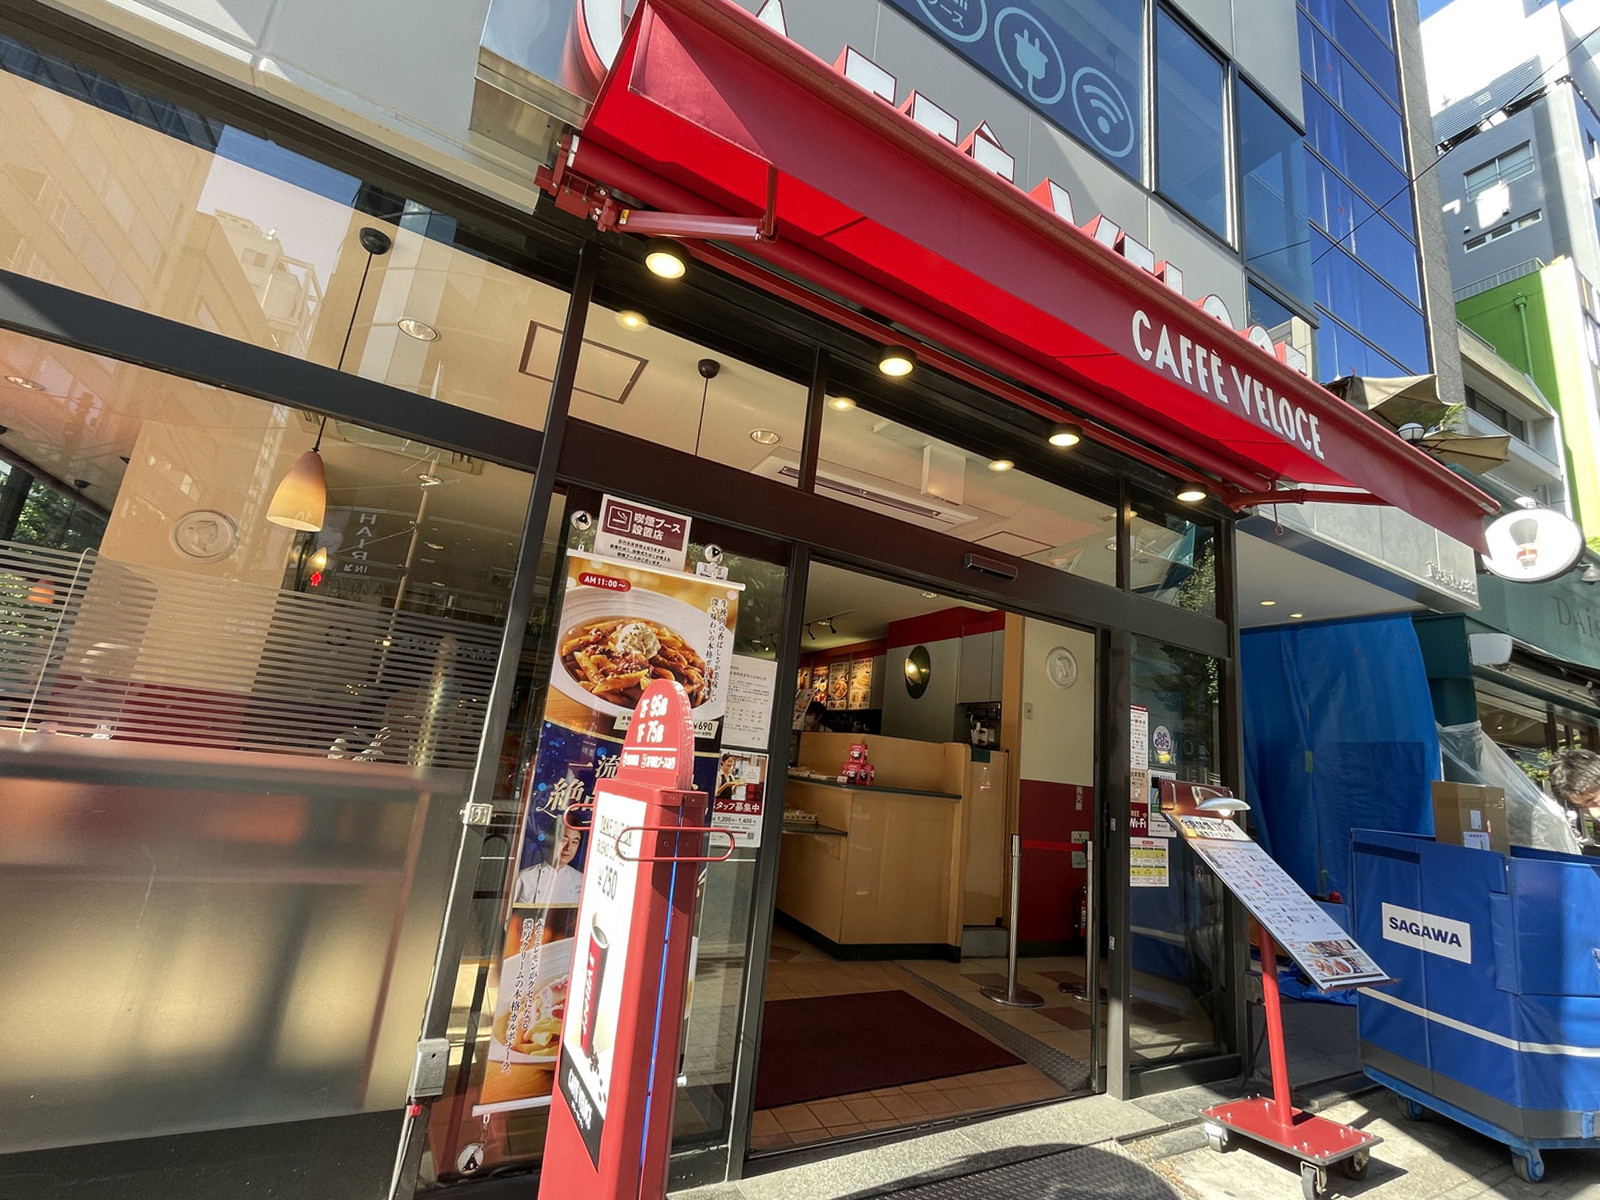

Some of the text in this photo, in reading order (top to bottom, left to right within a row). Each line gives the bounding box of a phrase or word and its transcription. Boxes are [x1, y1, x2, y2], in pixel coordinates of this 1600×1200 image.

[1132, 310, 1324, 460] CAFFÈ VELOCE
[631, 523, 664, 541] 設置店
[633, 512, 681, 534] 喫煙ブース
[584, 576, 597, 584] AM
[1389, 917, 1462, 948] SAGAWA
